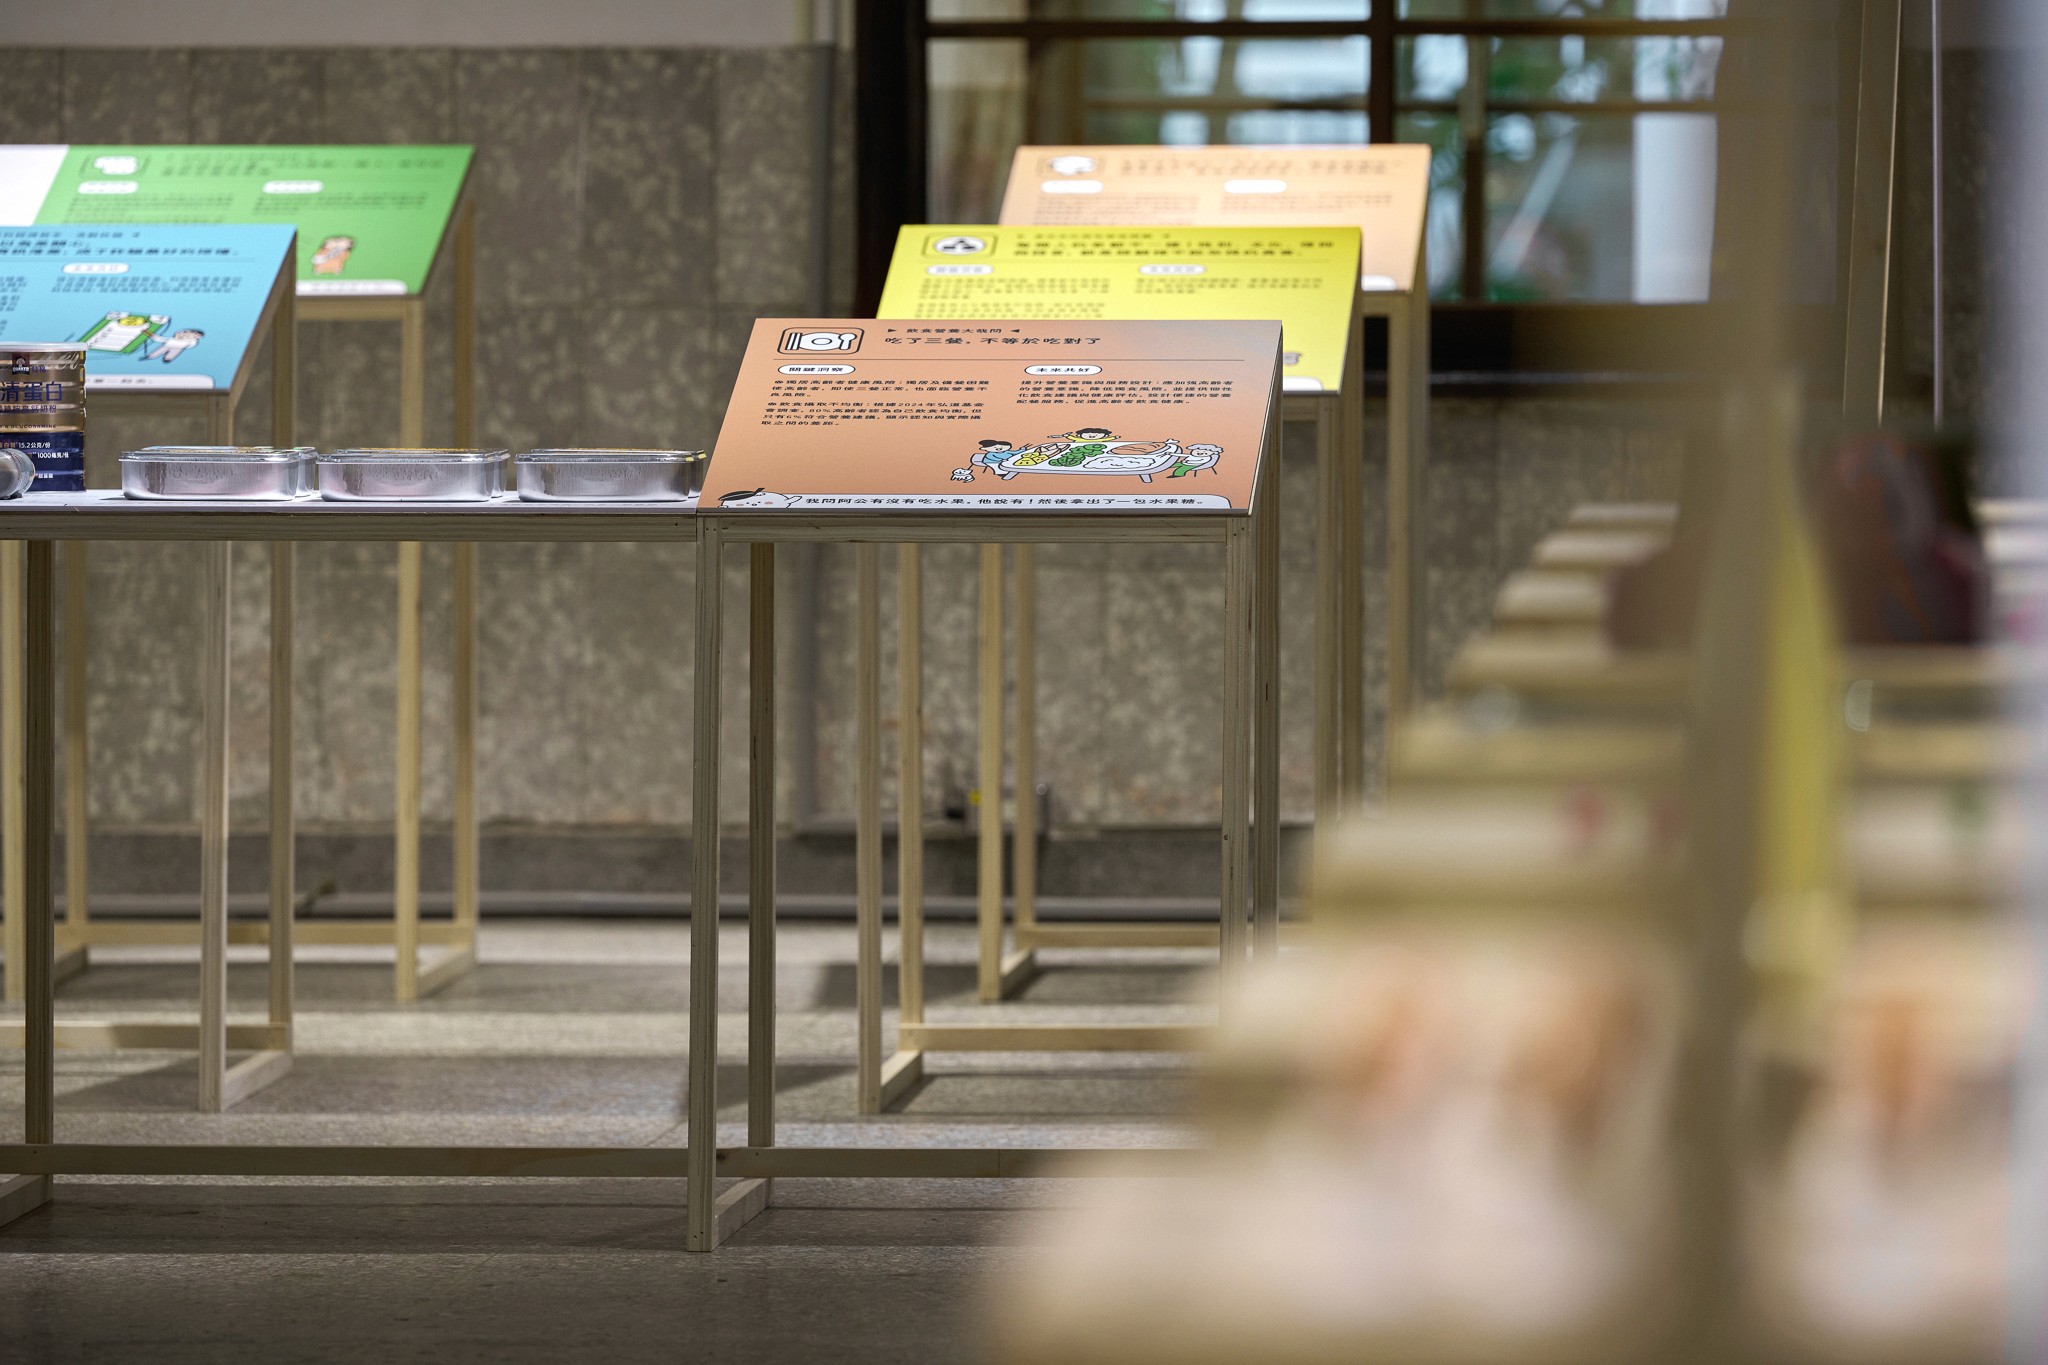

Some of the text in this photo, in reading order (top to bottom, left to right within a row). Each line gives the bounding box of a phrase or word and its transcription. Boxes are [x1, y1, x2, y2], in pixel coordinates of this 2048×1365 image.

[885, 337, 1101, 345] 吃了三餐，不等於吃對了
